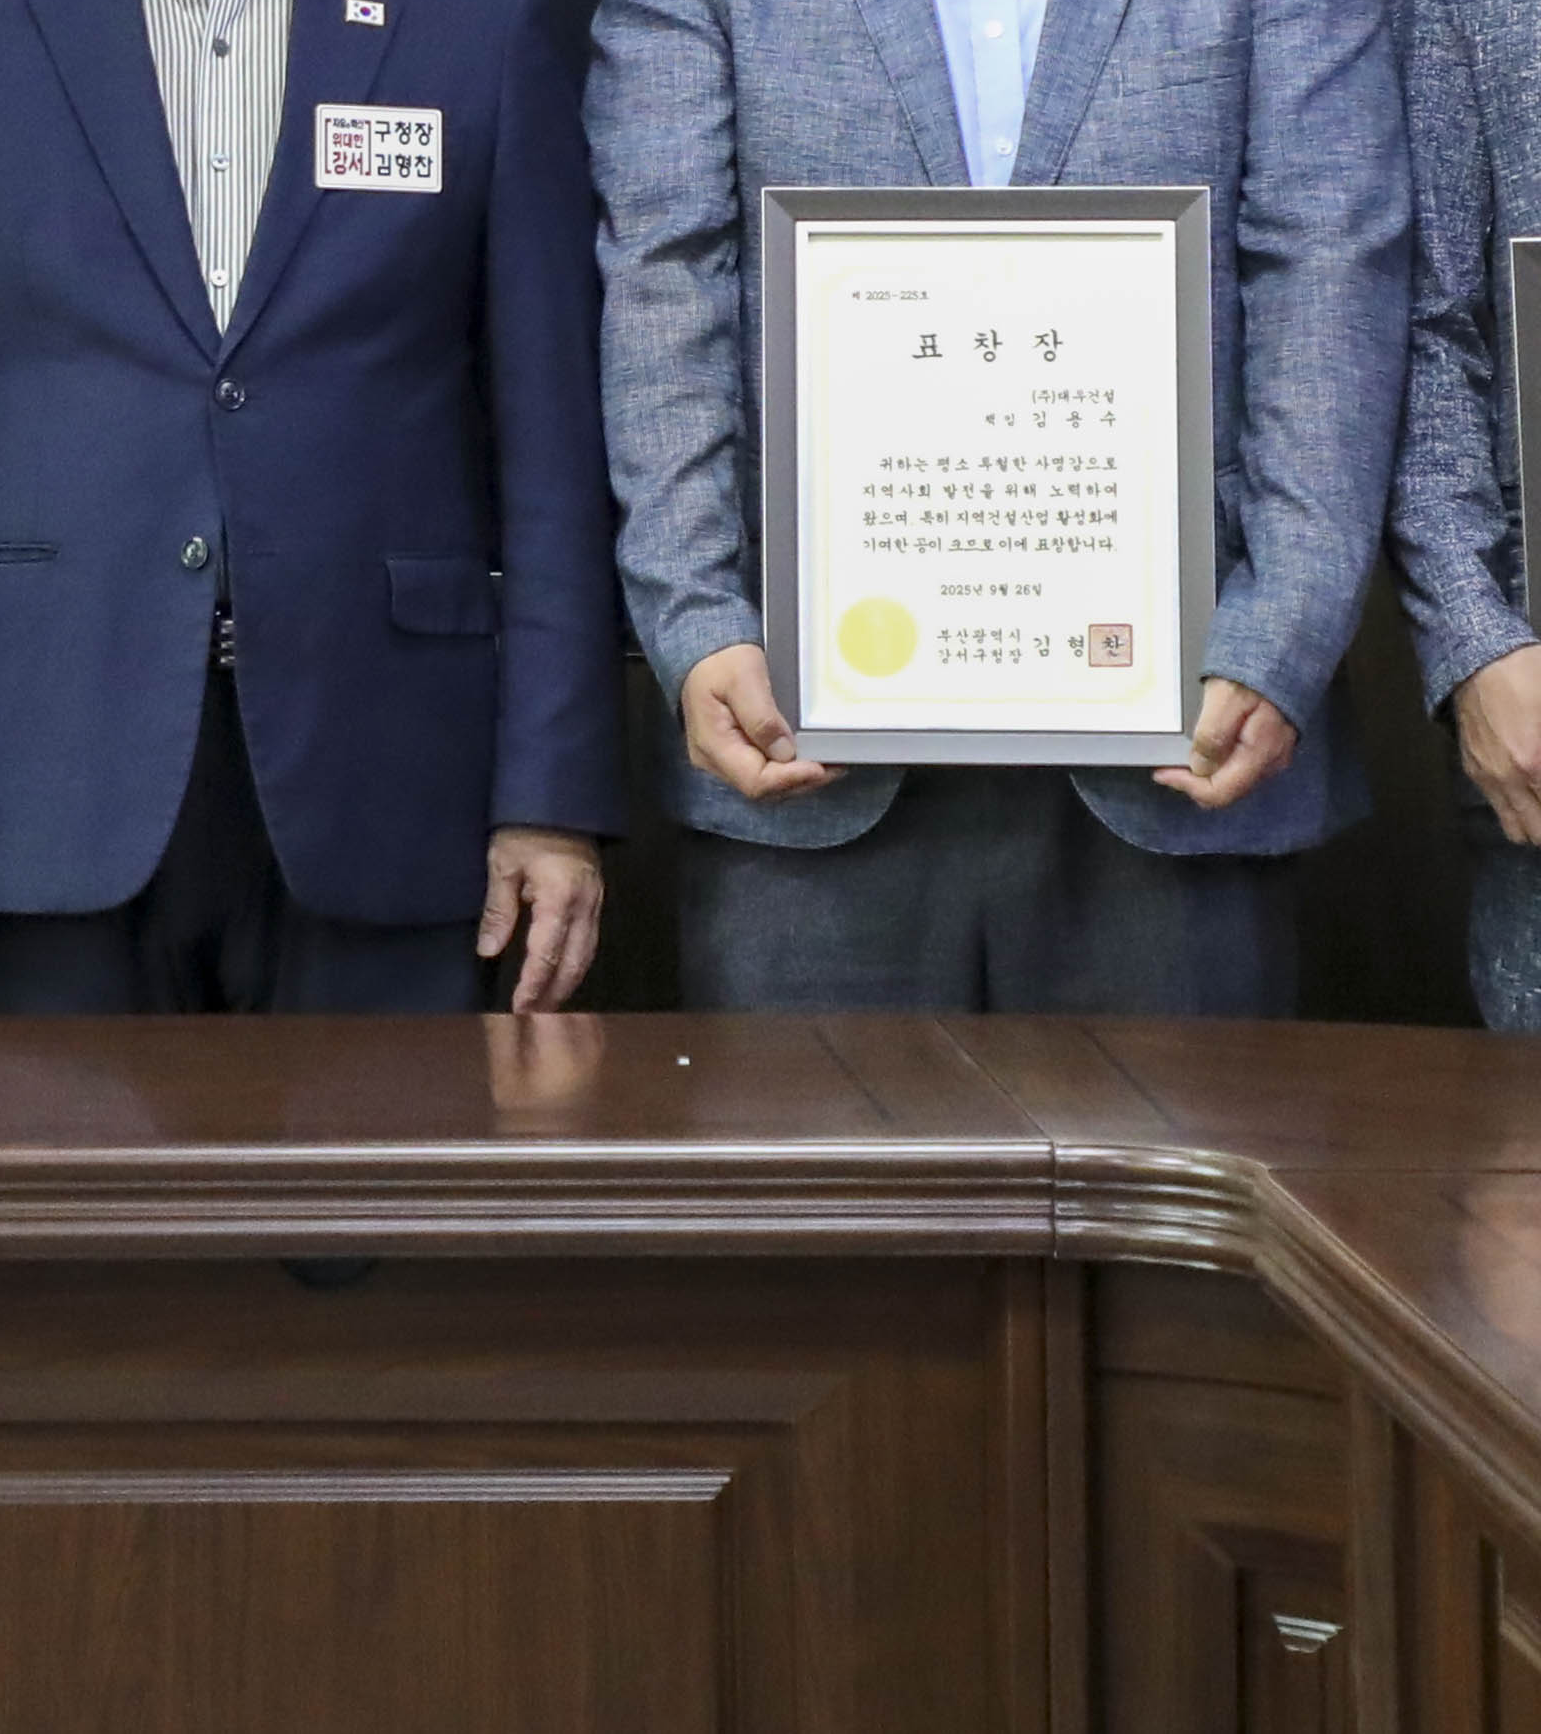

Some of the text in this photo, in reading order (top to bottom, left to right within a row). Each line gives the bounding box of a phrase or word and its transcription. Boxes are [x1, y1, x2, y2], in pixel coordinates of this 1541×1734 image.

[332, 133, 364, 148] 위대한
[375, 120, 433, 146] 구청장
[332, 152, 364, 175] 강서
[375, 154, 433, 179] 김형찬
[1032, 389, 1114, 404] (주)대우건설
[1066, 411, 1082, 428] 용
[1100, 411, 1116, 426] 수
[937, 628, 1020, 644] 부산광역시
[939, 648, 1022, 664] 강서구청장
